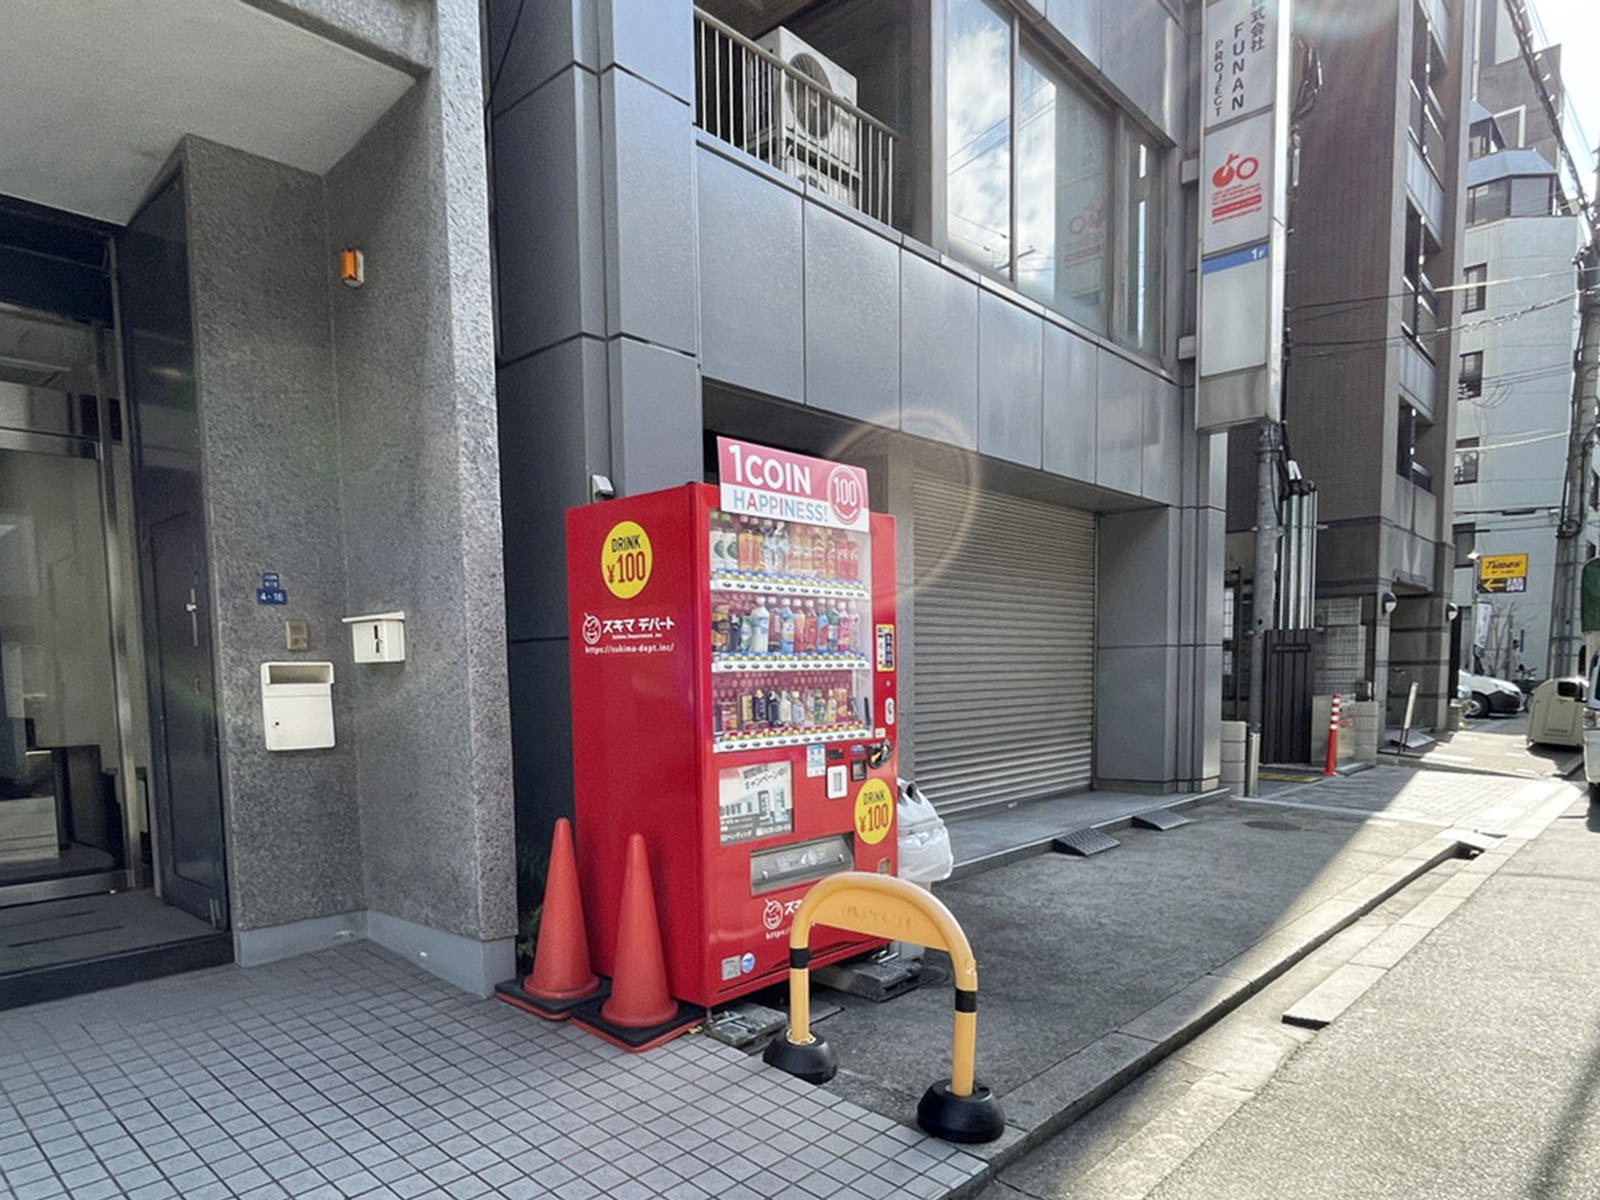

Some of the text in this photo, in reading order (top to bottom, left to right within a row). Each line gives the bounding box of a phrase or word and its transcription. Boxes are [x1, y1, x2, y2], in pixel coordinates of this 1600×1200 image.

[1213, 39, 1224, 117] PROJECT
[1232, 21, 1245, 111] FUNAN
[733, 489, 829, 523] HAPPINESS!
[833, 477, 857, 507] 100
[611, 534, 641, 552] DRINK
[607, 551, 646, 584] ¥100
[602, 618, 635, 634] スキマ
[863, 791, 886, 806] DRINK
[858, 803, 890, 833] ¥100
